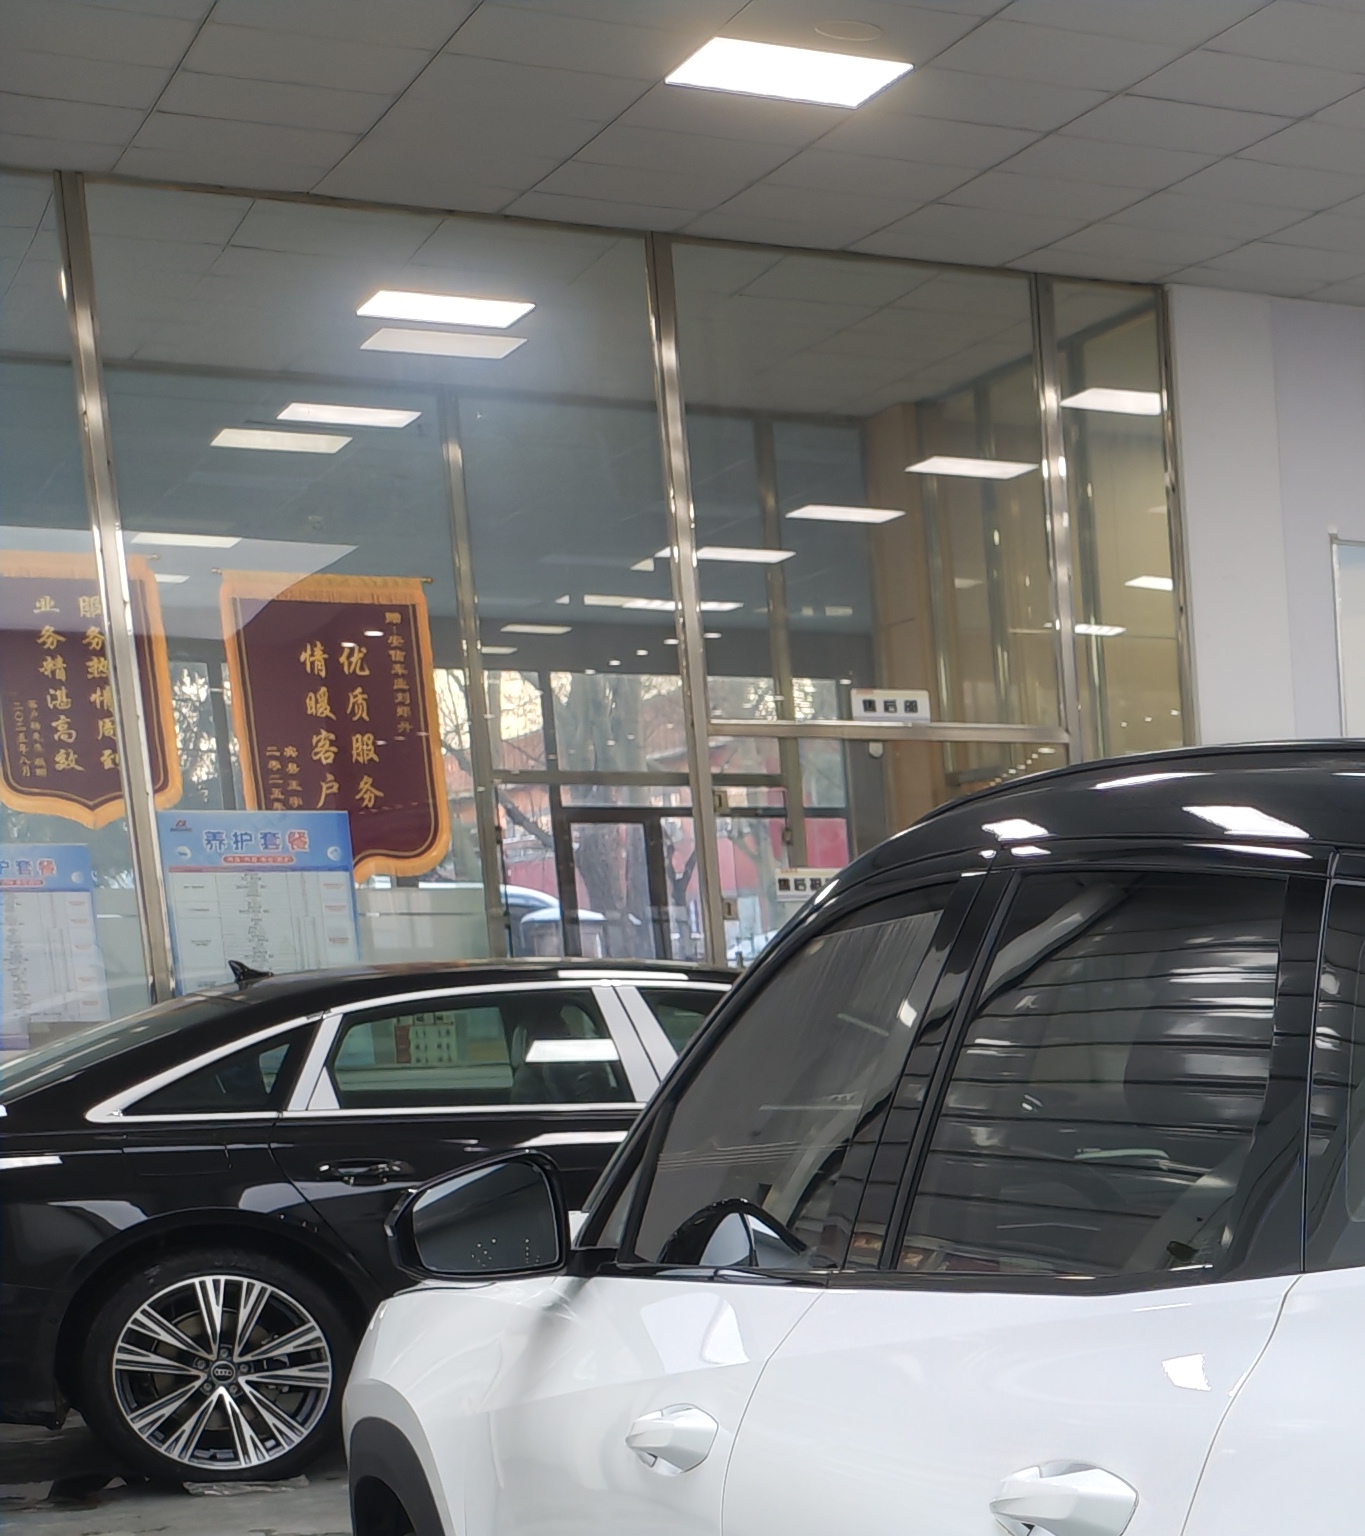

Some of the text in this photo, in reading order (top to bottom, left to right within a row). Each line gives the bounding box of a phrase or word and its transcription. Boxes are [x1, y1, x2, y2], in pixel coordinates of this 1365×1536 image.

[33, 595, 84, 772] 业务精湛高效
[300, 640, 340, 809] 情暖客户
[339, 645, 384, 809] 优质服务
[204, 831, 309, 851] 养护套餐
